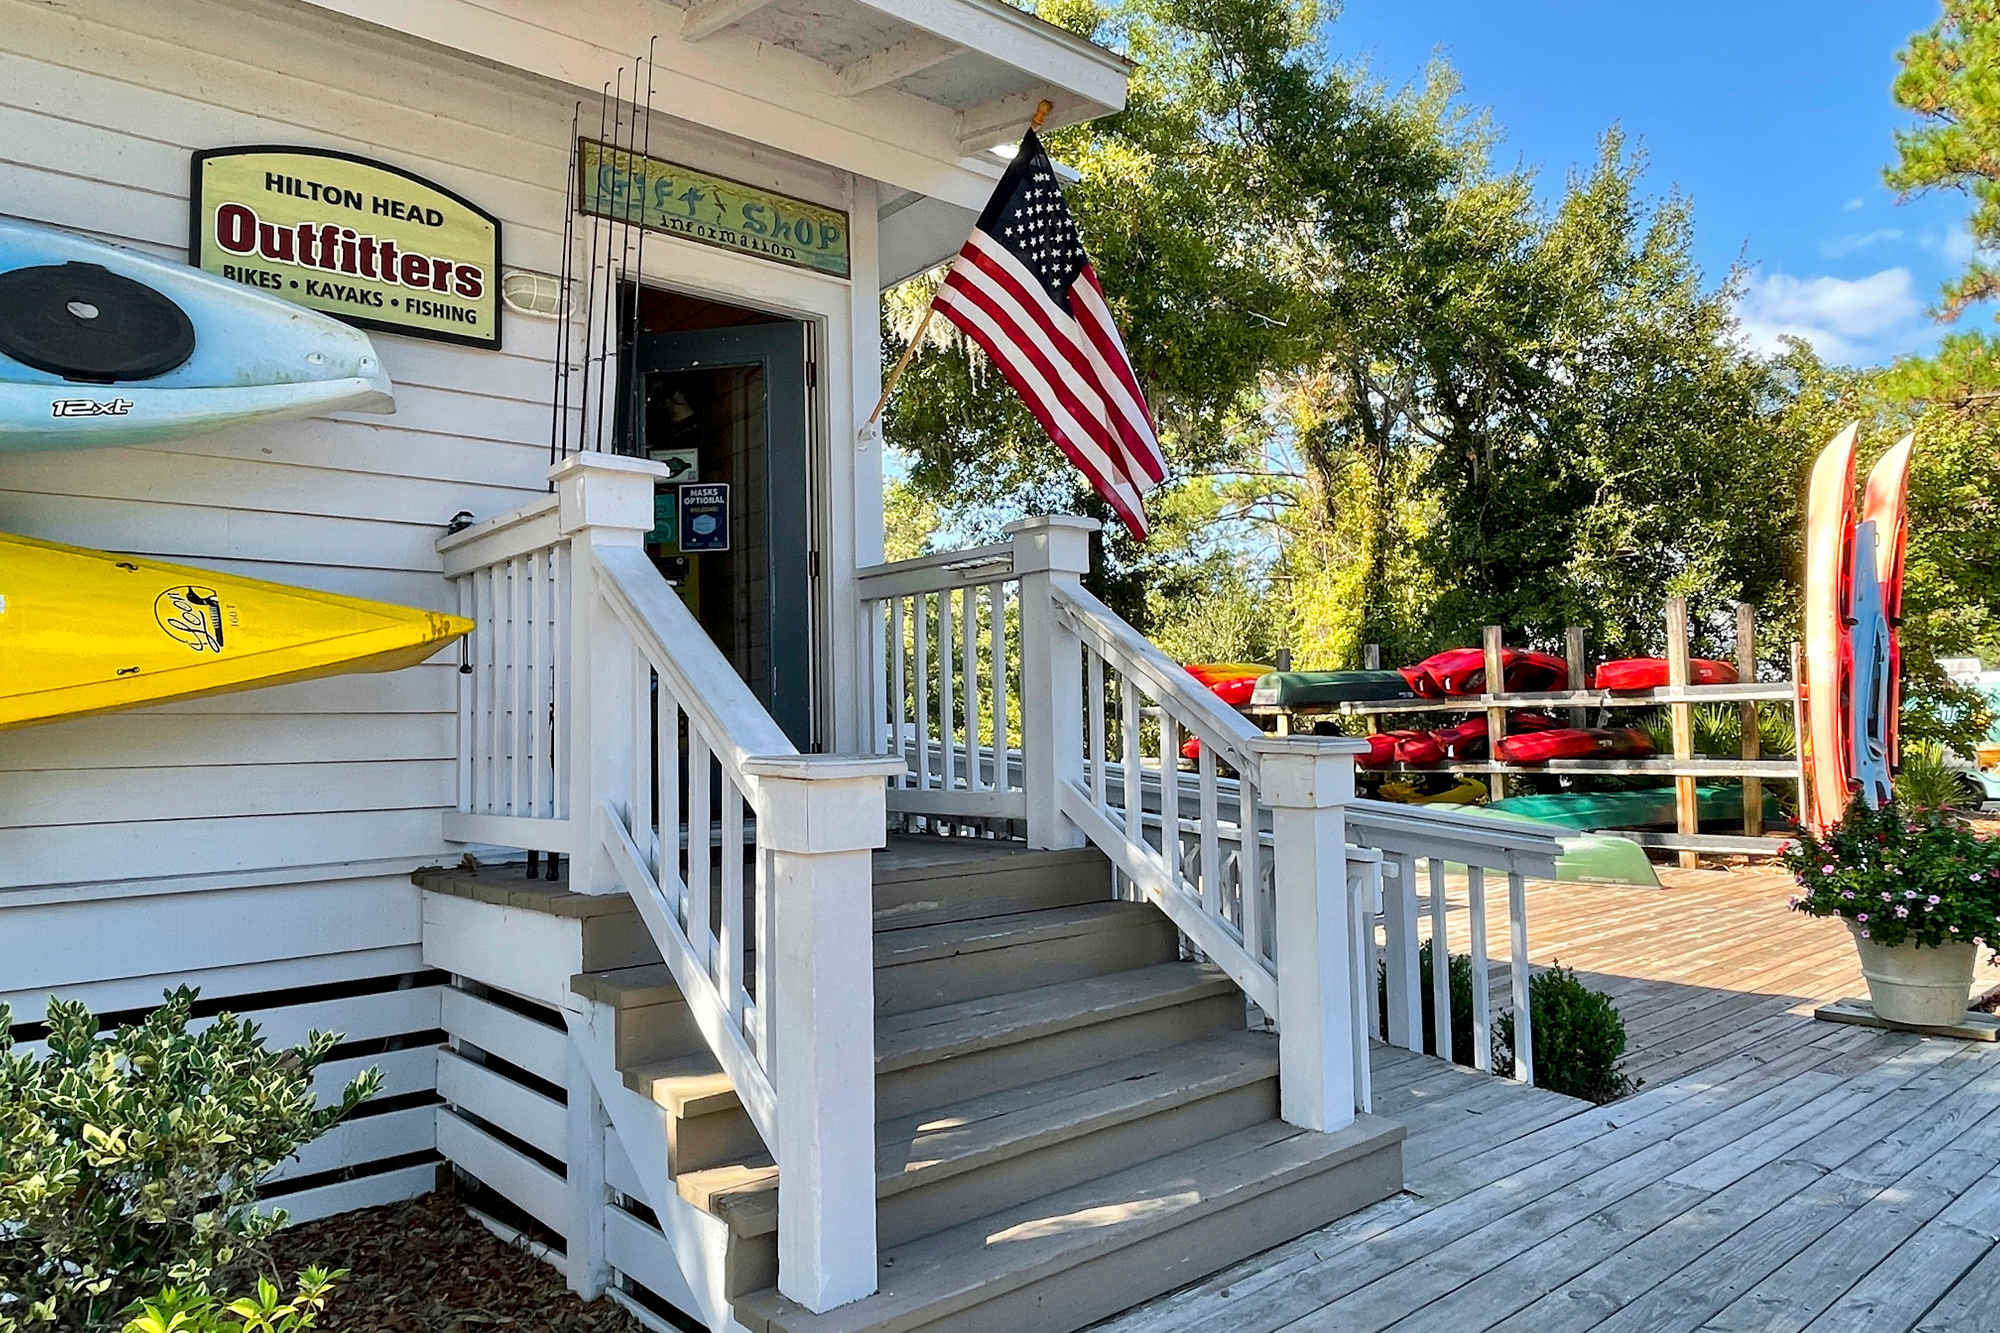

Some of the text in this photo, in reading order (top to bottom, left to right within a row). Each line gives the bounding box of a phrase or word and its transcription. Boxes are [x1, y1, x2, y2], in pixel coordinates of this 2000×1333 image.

[265, 172, 443, 227] HILTON HEAD
[216, 203, 483, 298] Outfitters
[660, 214, 797, 260] information
[223, 264, 477, 325] BIKES KAYAKS FISHING
[52, 399, 134, 417] 12xt
[684, 496, 725, 505] OPTIONAL
[690, 488, 718, 497] MASKS
